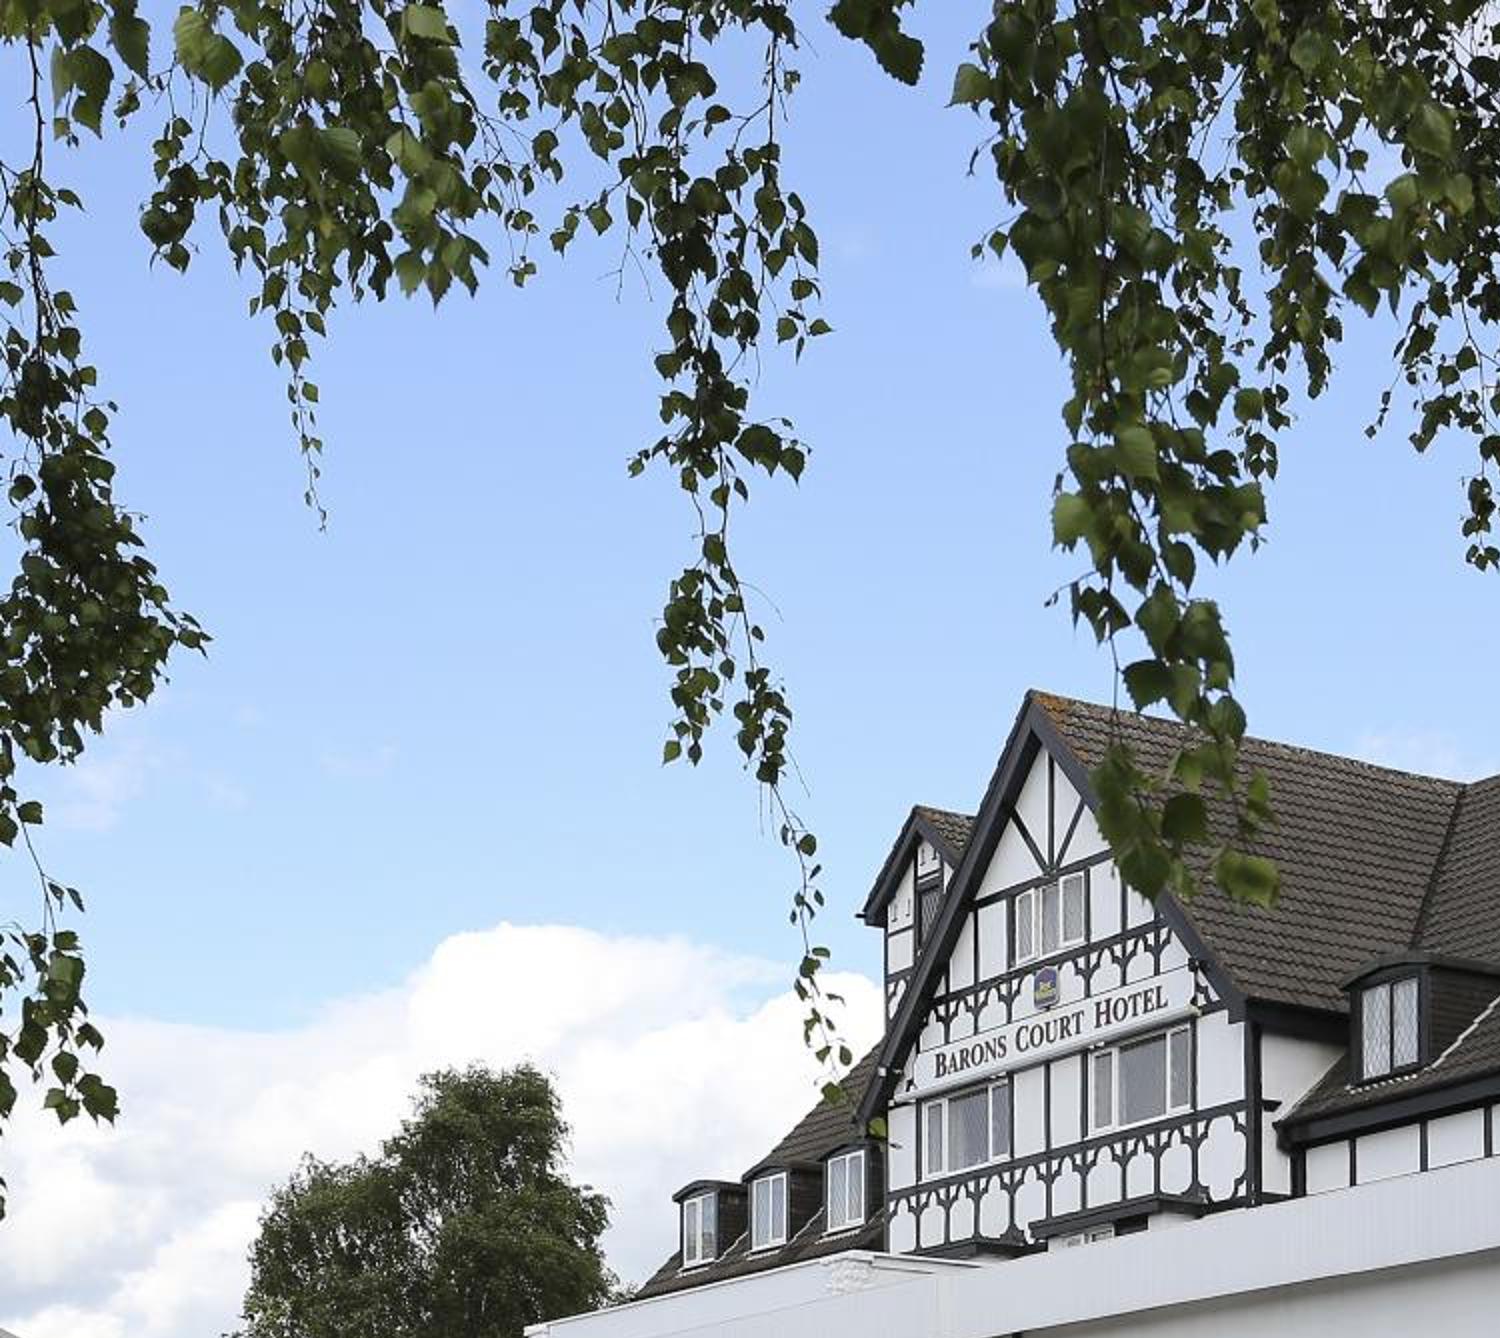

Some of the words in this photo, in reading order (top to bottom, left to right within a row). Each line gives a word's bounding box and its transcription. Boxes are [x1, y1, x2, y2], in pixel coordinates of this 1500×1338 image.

[935, 1035, 1007, 1079] BARONS
[1015, 1010, 1085, 1052] COURT
[1094, 985, 1168, 1029] HOTEL
